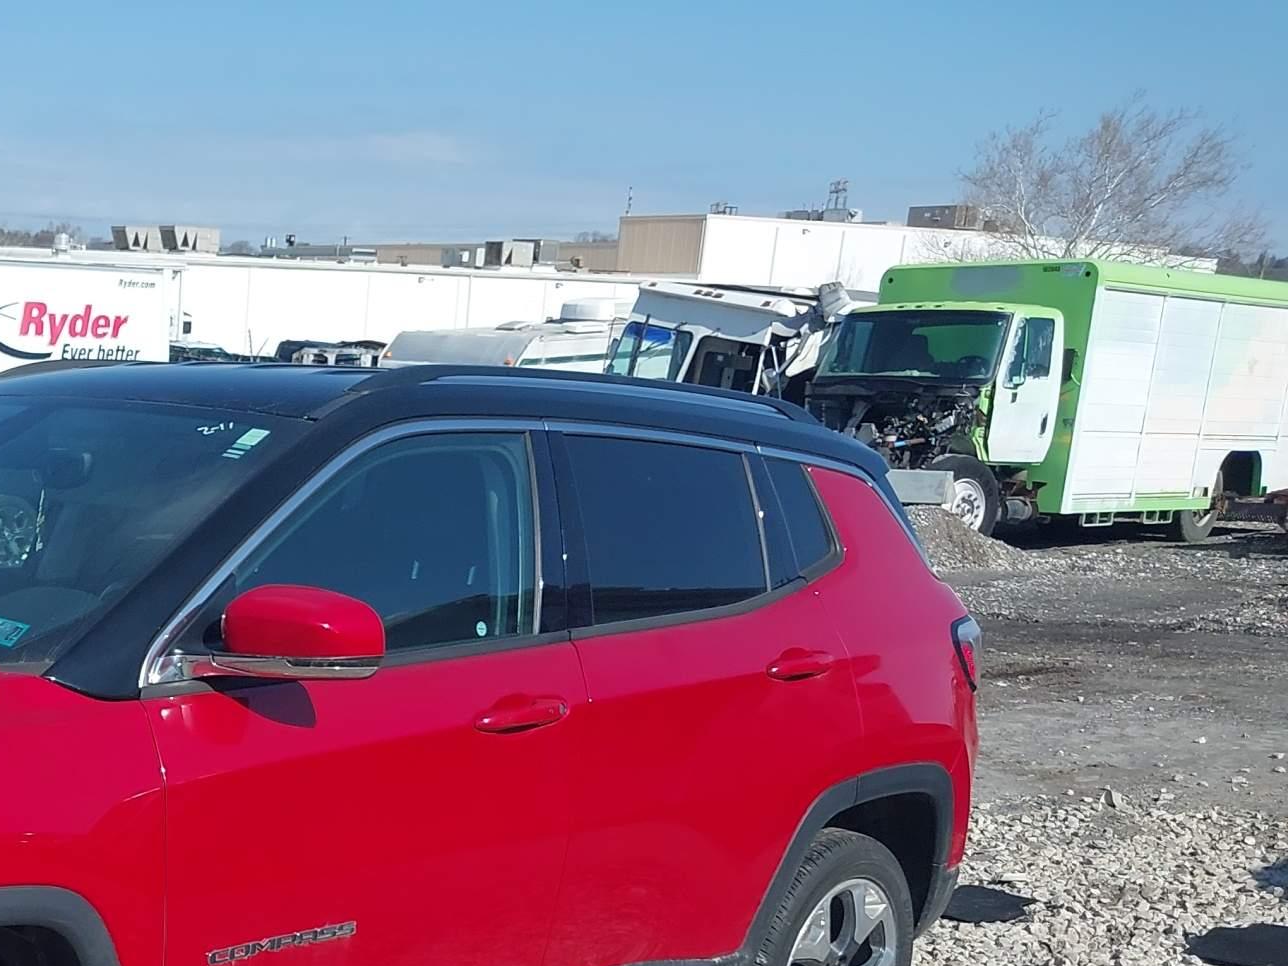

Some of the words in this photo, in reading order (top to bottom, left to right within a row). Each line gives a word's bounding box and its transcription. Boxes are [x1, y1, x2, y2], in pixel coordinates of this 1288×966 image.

[118, 278, 156, 290] Ryder.com
[19, 301, 129, 346] Ryder
[62, 343, 94, 361] Ever
[97, 344, 141, 361] better
[208, 920, 357, 965] COMPASS
